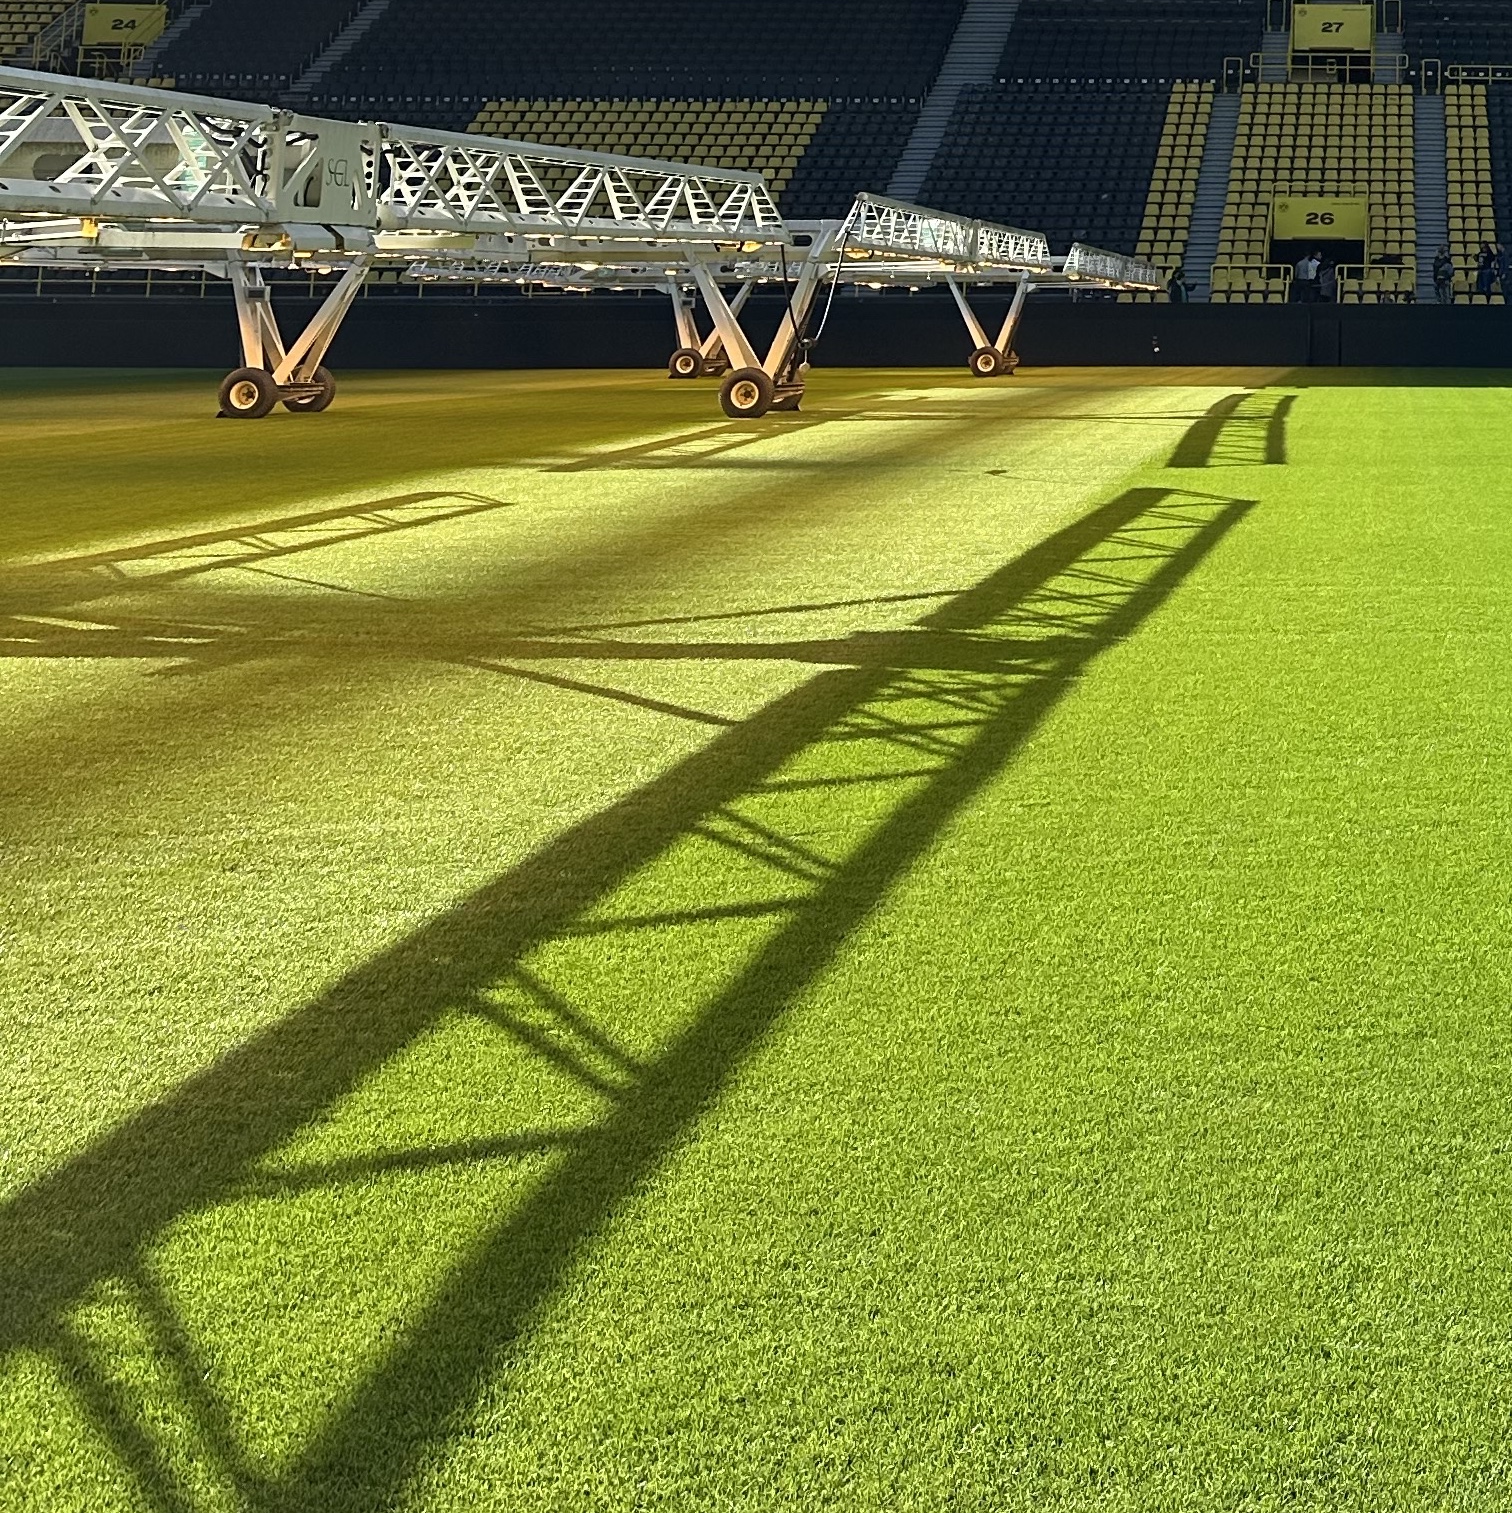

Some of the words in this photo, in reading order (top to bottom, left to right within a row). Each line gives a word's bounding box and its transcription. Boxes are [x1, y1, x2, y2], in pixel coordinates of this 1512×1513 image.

[111, 18, 136, 30] 24
[1321, 21, 1345, 33] 27
[1305, 212, 1335, 225] 26
